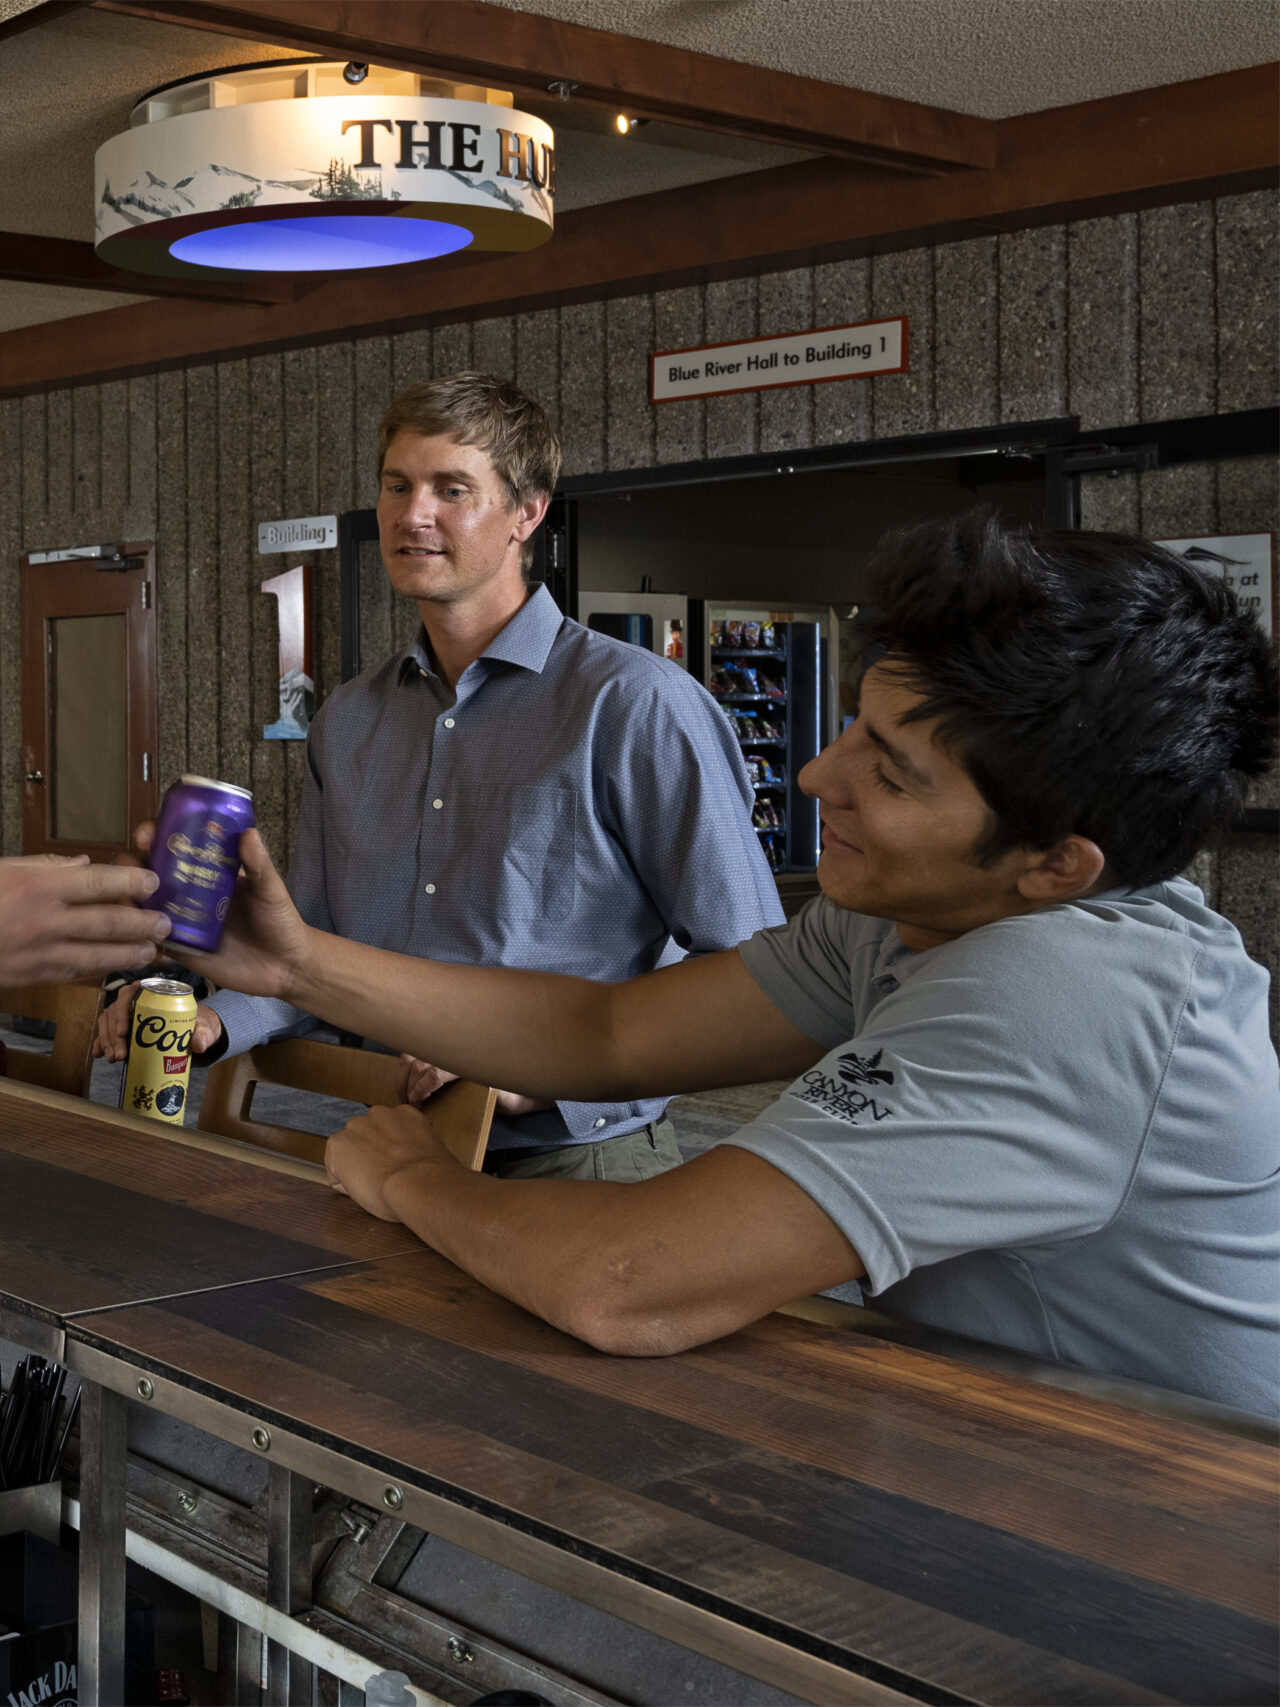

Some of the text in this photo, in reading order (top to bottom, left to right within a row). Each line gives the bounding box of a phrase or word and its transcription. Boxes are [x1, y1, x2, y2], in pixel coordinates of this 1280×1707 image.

[341, 119, 484, 172] THE
[669, 336, 886, 383] Blue River Hall to Building 1
[267, 524, 327, 545] Building
[1240, 572, 1259, 586] at
[261, 564, 314, 740] 1
[135, 1013, 192, 1053] Coo
[802, 1070, 893, 1121] CANYON
[803, 1086, 859, 1118] RIVER
